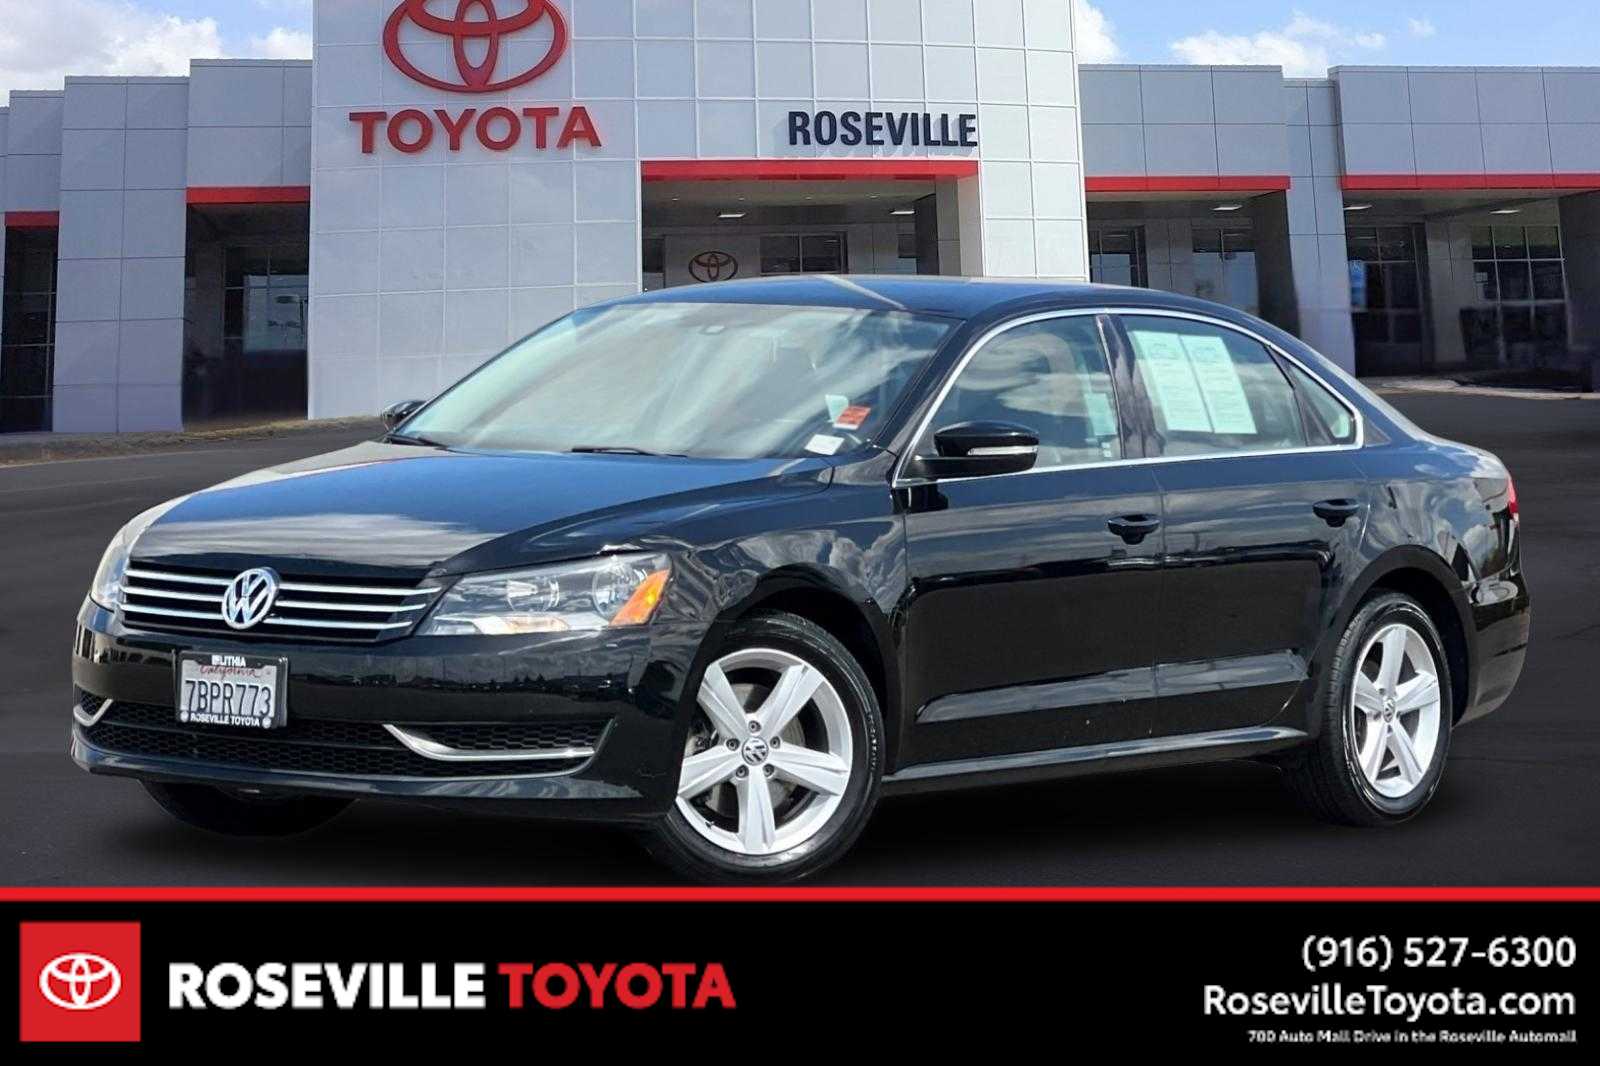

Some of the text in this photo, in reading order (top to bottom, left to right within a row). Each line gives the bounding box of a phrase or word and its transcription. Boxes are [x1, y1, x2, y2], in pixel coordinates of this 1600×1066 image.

[349, 106, 602, 154] TOYOTA
[788, 111, 978, 148] ROSEVILLE
[184, 679, 271, 718] 7BPR773
[190, 712, 260, 727] ROSEVILLE TOYOTA
